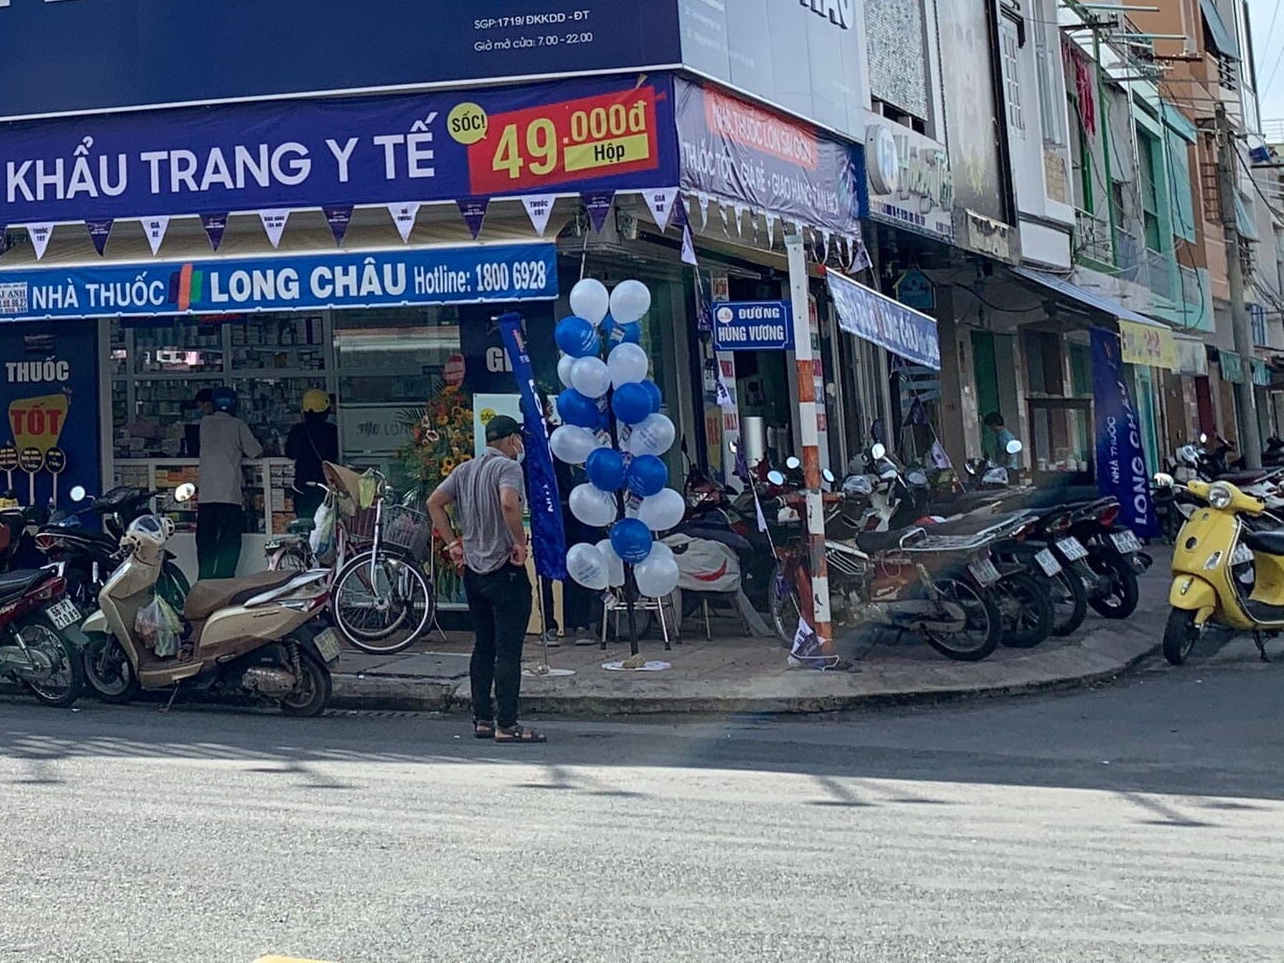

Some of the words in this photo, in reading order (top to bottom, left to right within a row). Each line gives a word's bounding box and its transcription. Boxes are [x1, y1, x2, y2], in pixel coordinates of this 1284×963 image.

[574, 10, 591, 21] ĐT
[474, 39, 493, 52] Giờ
[494, 37, 511, 50] mở
[512, 36, 536, 49] cửa:
[537, 35, 559, 46] 7.00
[566, 32, 594, 44] 22.00
[451, 110, 486, 133] SỐC!
[733, 108, 764, 143] THUỐC
[6, 136, 128, 203] KHẨU
[140, 143, 312, 194] TRANG
[325, 137, 359, 183] Y
[373, 112, 439, 180] TẾ
[594, 143, 625, 163] Hộp
[682, 137, 715, 178] THUỐC
[771, 172, 792, 205] GIAO
[654, 193, 666, 203] GIÁ
[7, 288, 26, 298] ANH
[32, 277, 79, 309] NHÀ
[85, 271, 165, 308] THUỐC
[210, 267, 300, 303] LONG
[310, 256, 407, 297] CHÂU
[414, 265, 470, 294] Hotline:
[476, 261, 508, 291] 1800
[512, 259, 547, 290] 6928
[738, 305, 780, 320] ĐƯỜNG
[718, 322, 747, 342] HÙNG
[748, 323, 784, 342] VƯƠNG
[5, 355, 70, 382] THUỐC
[11, 402, 63, 436] TỐT
[1112, 458, 1120, 484] NHÀ
[1131, 461, 1148, 526] LONG
